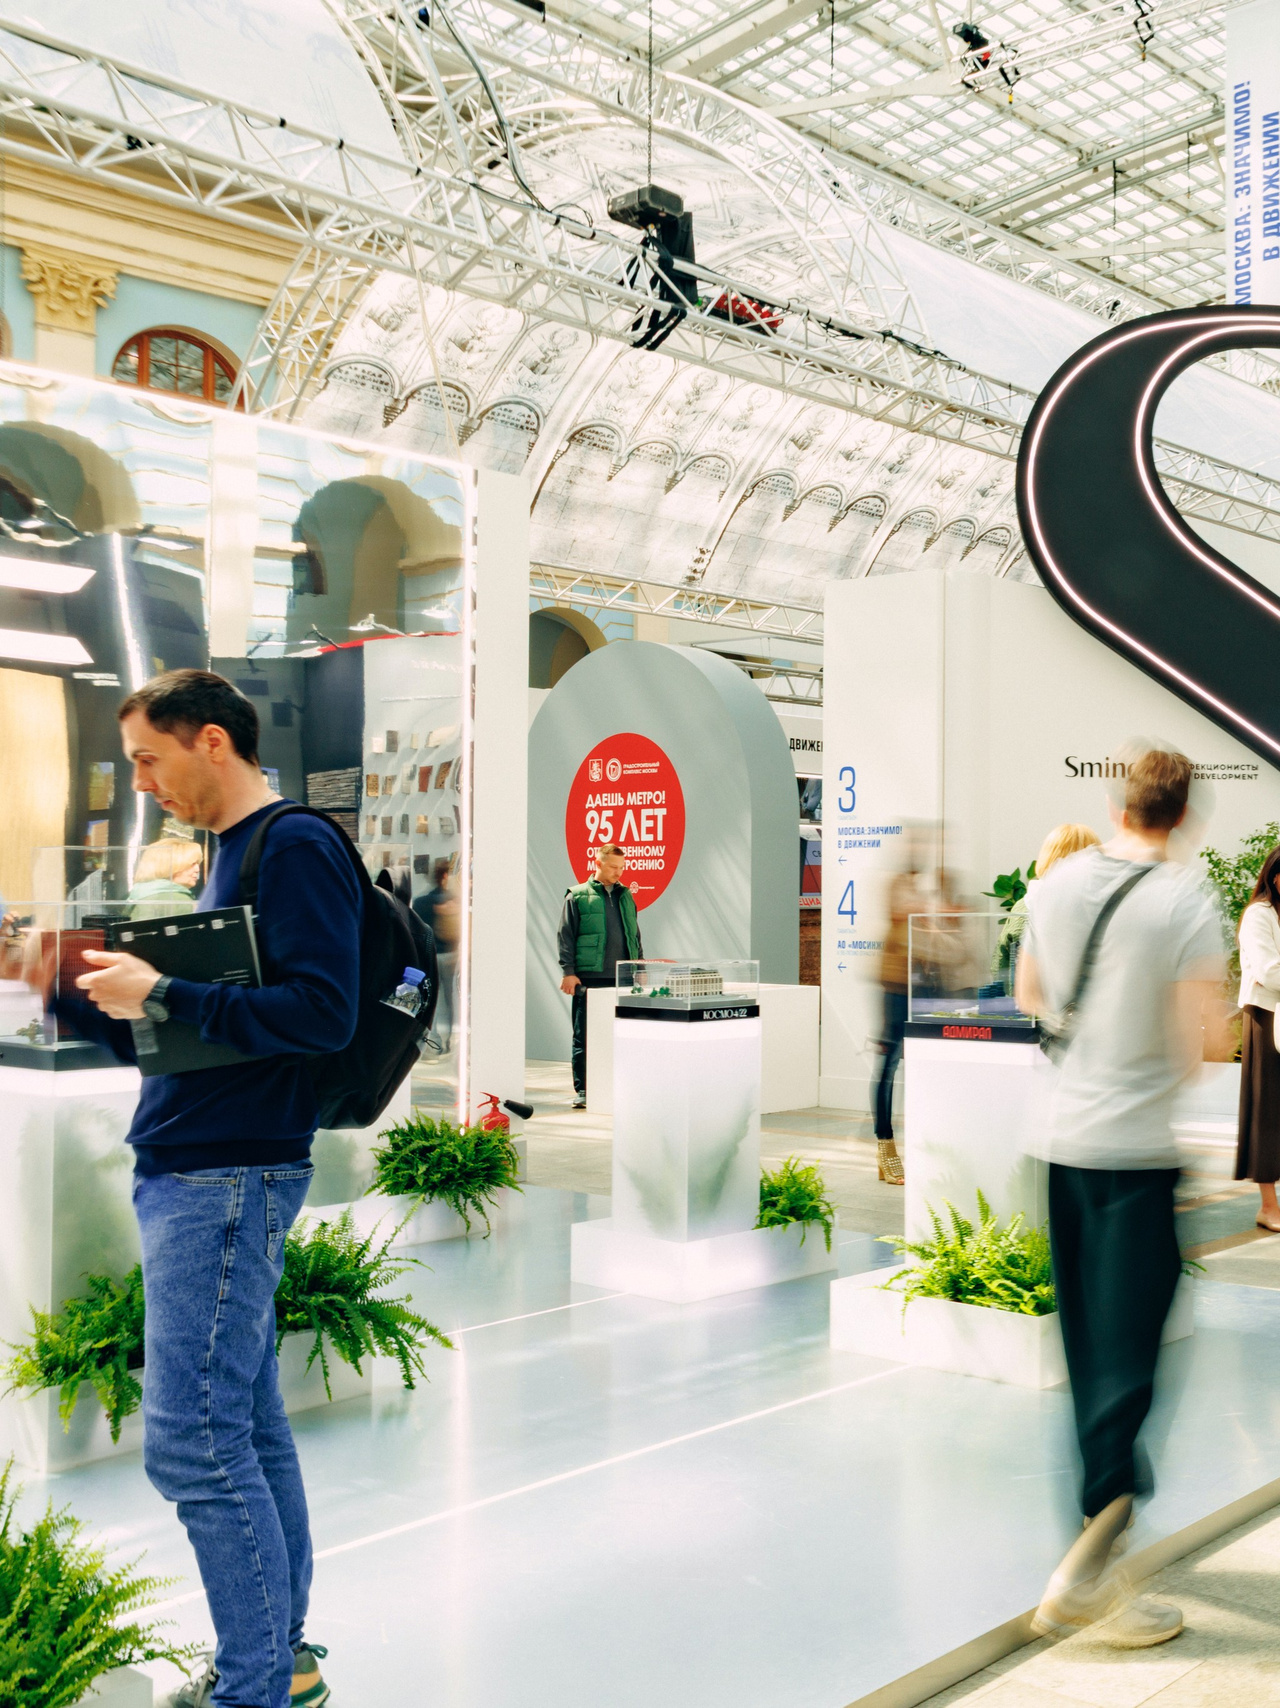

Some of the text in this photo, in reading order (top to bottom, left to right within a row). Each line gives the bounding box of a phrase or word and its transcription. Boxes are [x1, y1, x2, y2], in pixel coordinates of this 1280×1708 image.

[1233, 80, 1252, 198] ЗНАЧИМО!
[1262, 245, 1280, 262] В
[789, 737, 823, 752] ДВИЖЕ
[1064, 755, 1135, 778] Smin
[1194, 772, 1259, 780] DEVELOPMENT
[838, 765, 856, 813] 3
[585, 790, 666, 809] ДАЕШЬ МЕТРО!
[585, 808, 667, 843] 95 ЛЕТ
[838, 839, 881, 849] В ДВИЖЕНИИ
[838, 879, 858, 926] 4
[837, 940, 846, 950] АО
